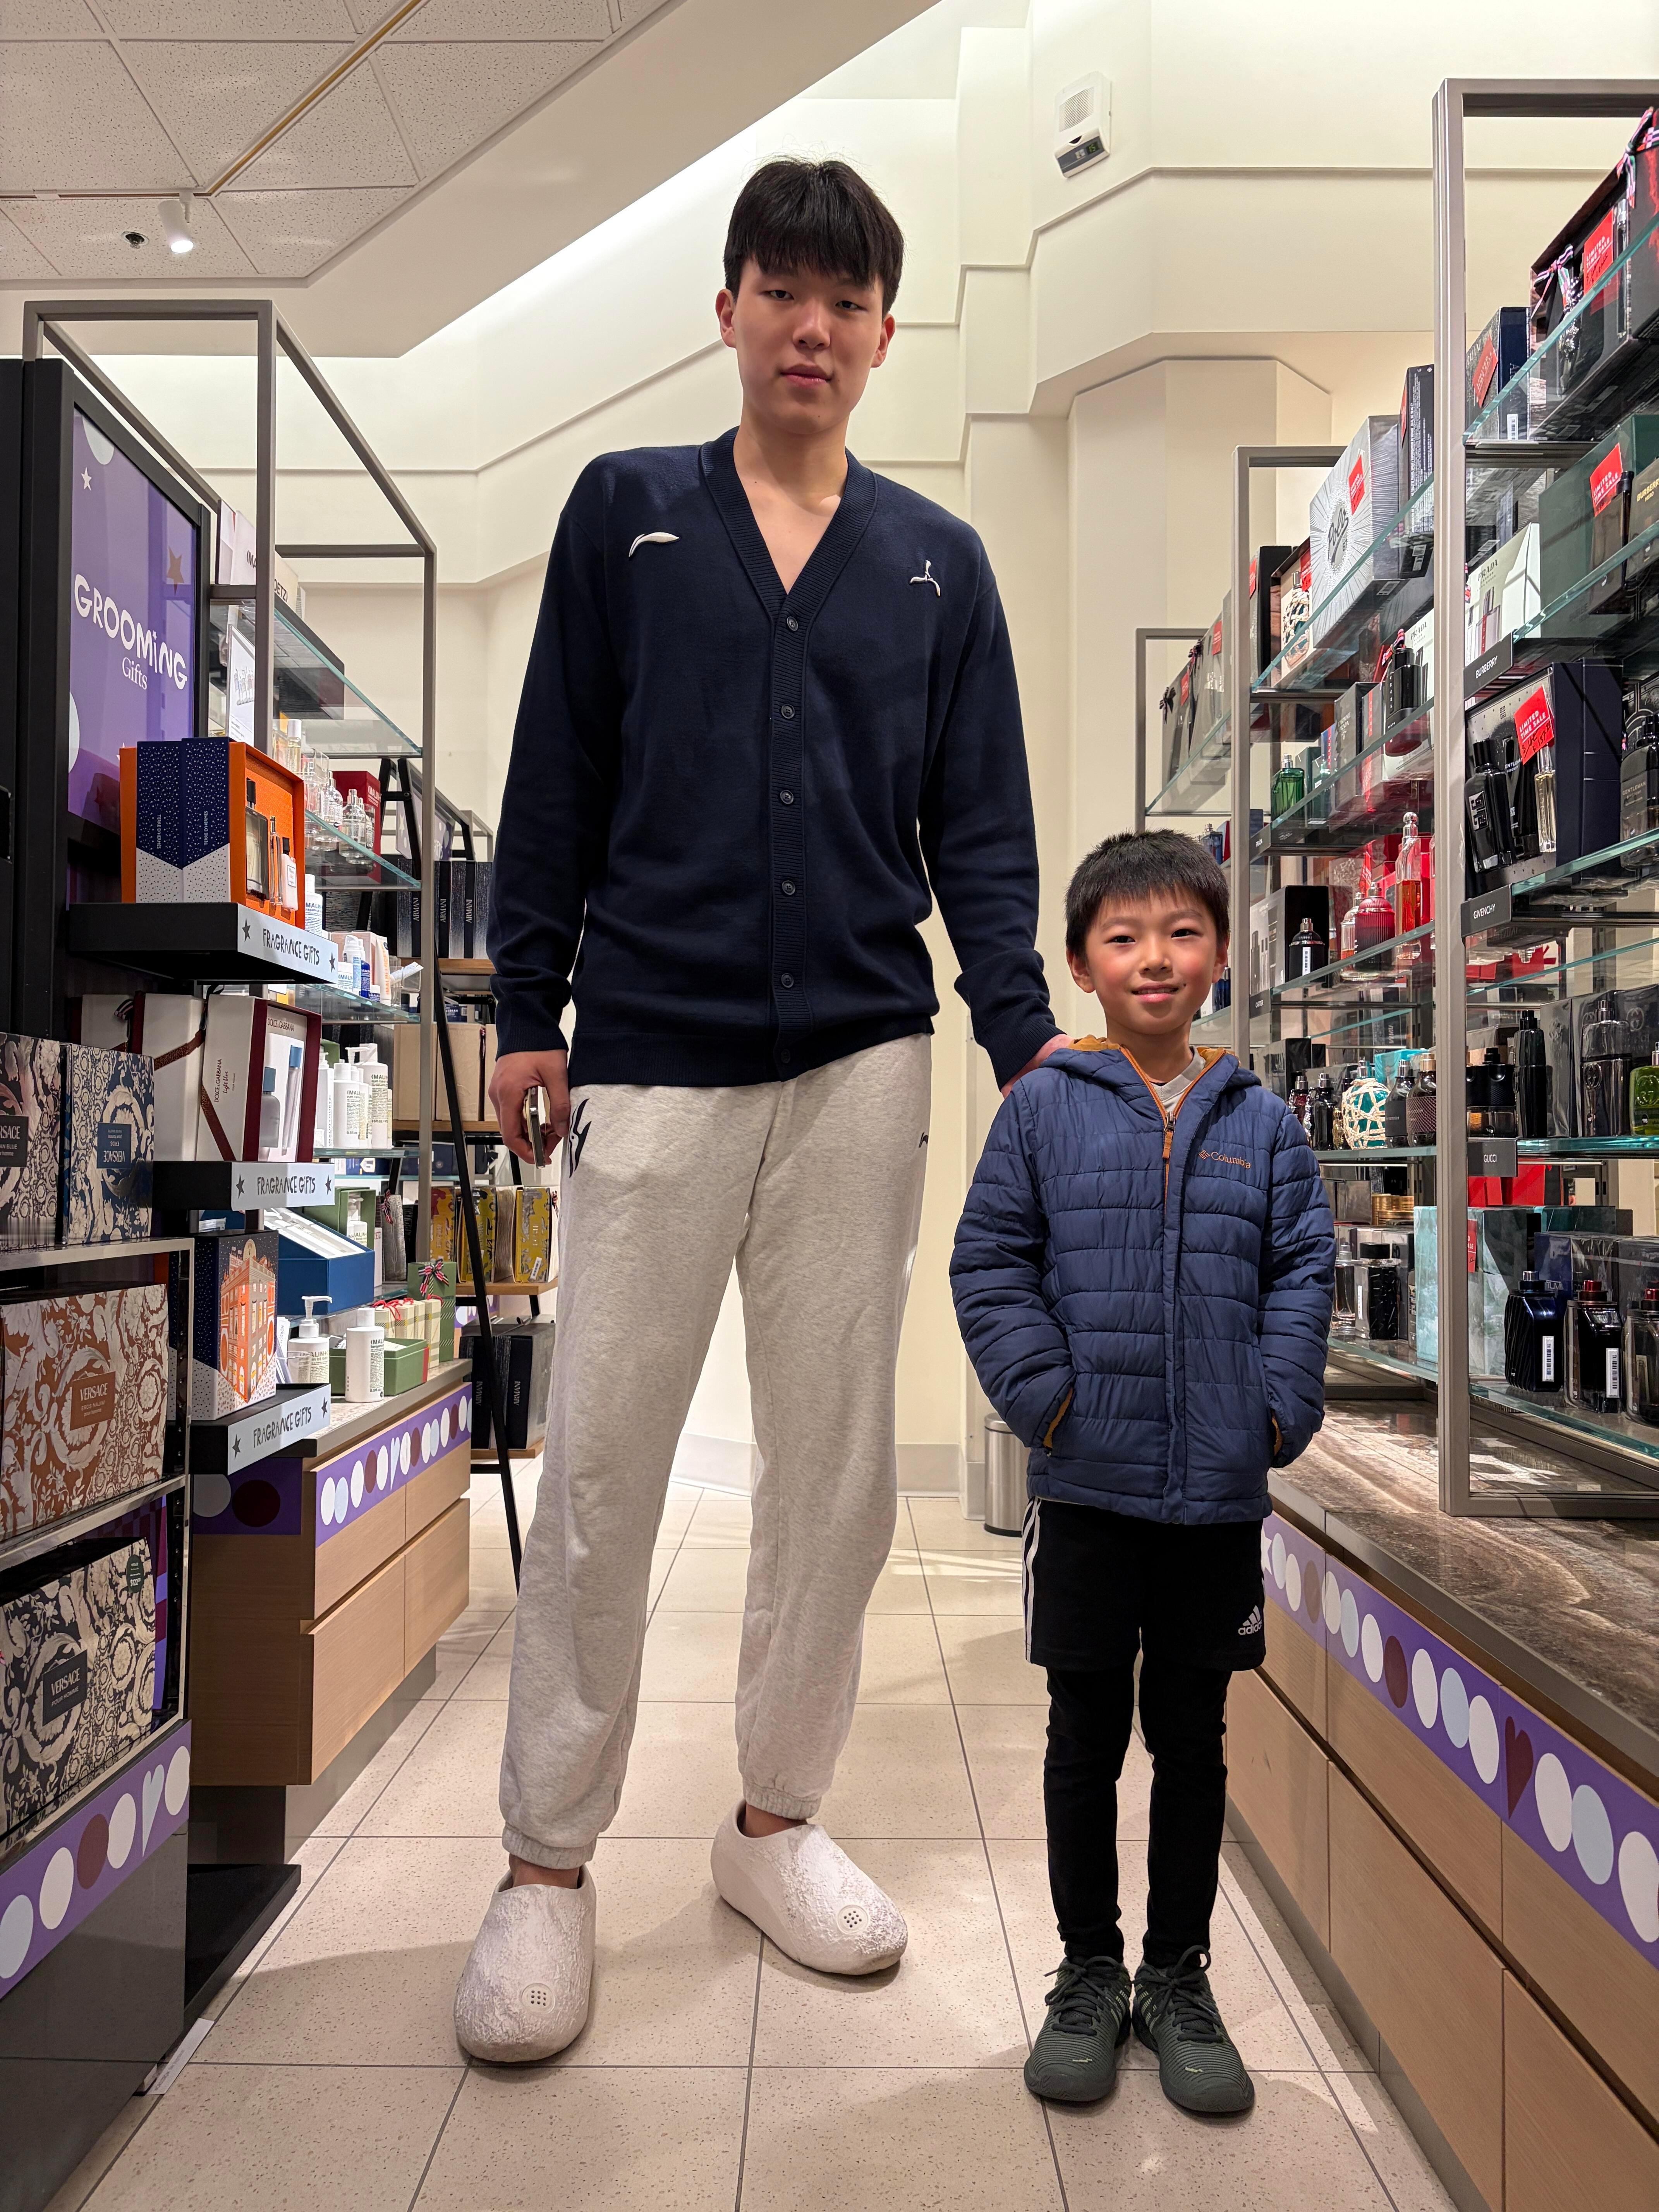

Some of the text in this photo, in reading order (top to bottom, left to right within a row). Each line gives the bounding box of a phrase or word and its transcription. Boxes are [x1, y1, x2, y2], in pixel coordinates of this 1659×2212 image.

[1593, 471, 1612, 497] LIMITED
[1594, 472, 1618, 503] TIME SALE
[1478, 559, 1498, 581] PRADA
[1410, 621, 1427, 640] PRADA
[122, 657, 147, 690] Gifts
[1475, 655, 1498, 679] BURBERRY
[1519, 710, 1539, 733] LIMITED
[1520, 711, 1546, 740] TIME SALE
[1473, 903, 1496, 919] GIVENCHY
[263, 928, 302, 959] FRAGRANCE
[103, 1150, 125, 1162] VERSACE
[1211, 1151, 1252, 1169] Columbia
[1483, 1154, 1497, 1163] GUCCI
[257, 1176, 297, 1195] FRAGRANCE
[80, 1383, 108, 1401] VERSACE
[253, 1412, 293, 1448] FRAGRANCE
[51, 1668, 80, 1696] VERSACE
[52, 1686, 79, 1707] POUR HOMME
